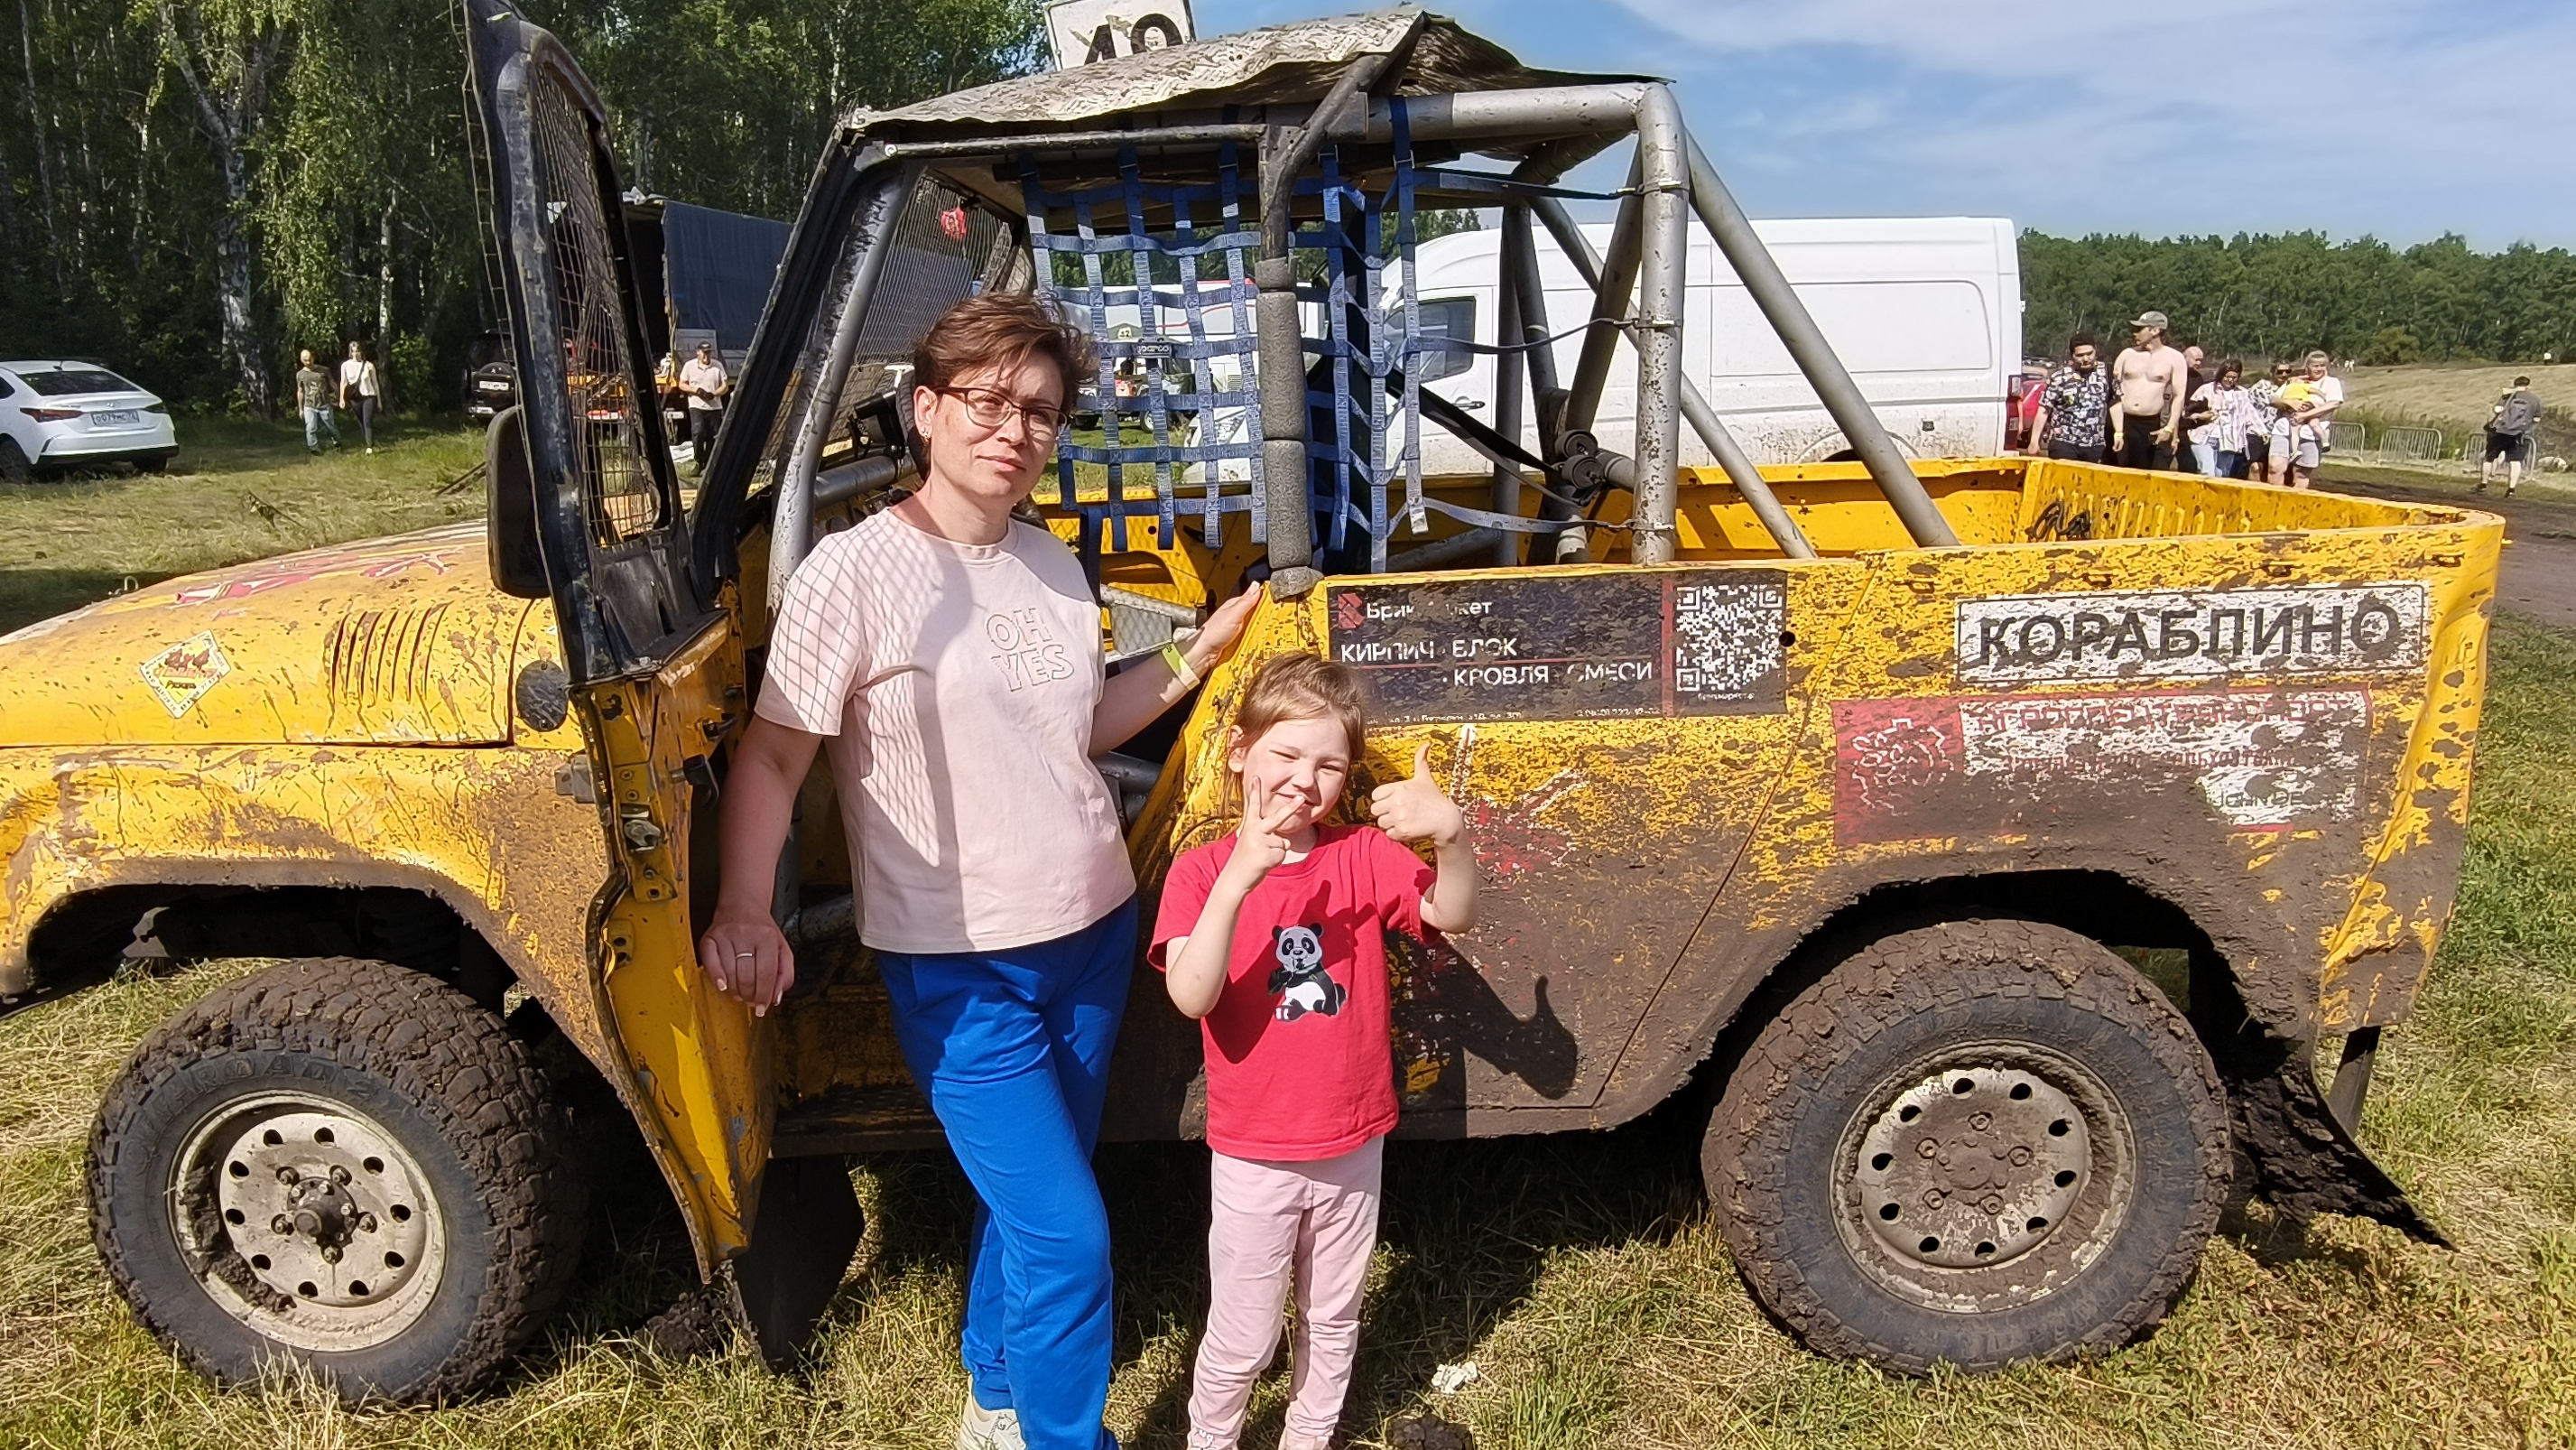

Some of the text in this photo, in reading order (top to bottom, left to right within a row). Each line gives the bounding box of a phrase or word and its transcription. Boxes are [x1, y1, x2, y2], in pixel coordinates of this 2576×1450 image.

[987, 608, 1052, 651] OH
[1980, 603, 2401, 666] КОРАБЛИНО
[991, 644, 1074, 692] YES
[1341, 640, 1434, 663] КИРПИЧ
[1453, 665, 1549, 687] КРОВЛЯ
